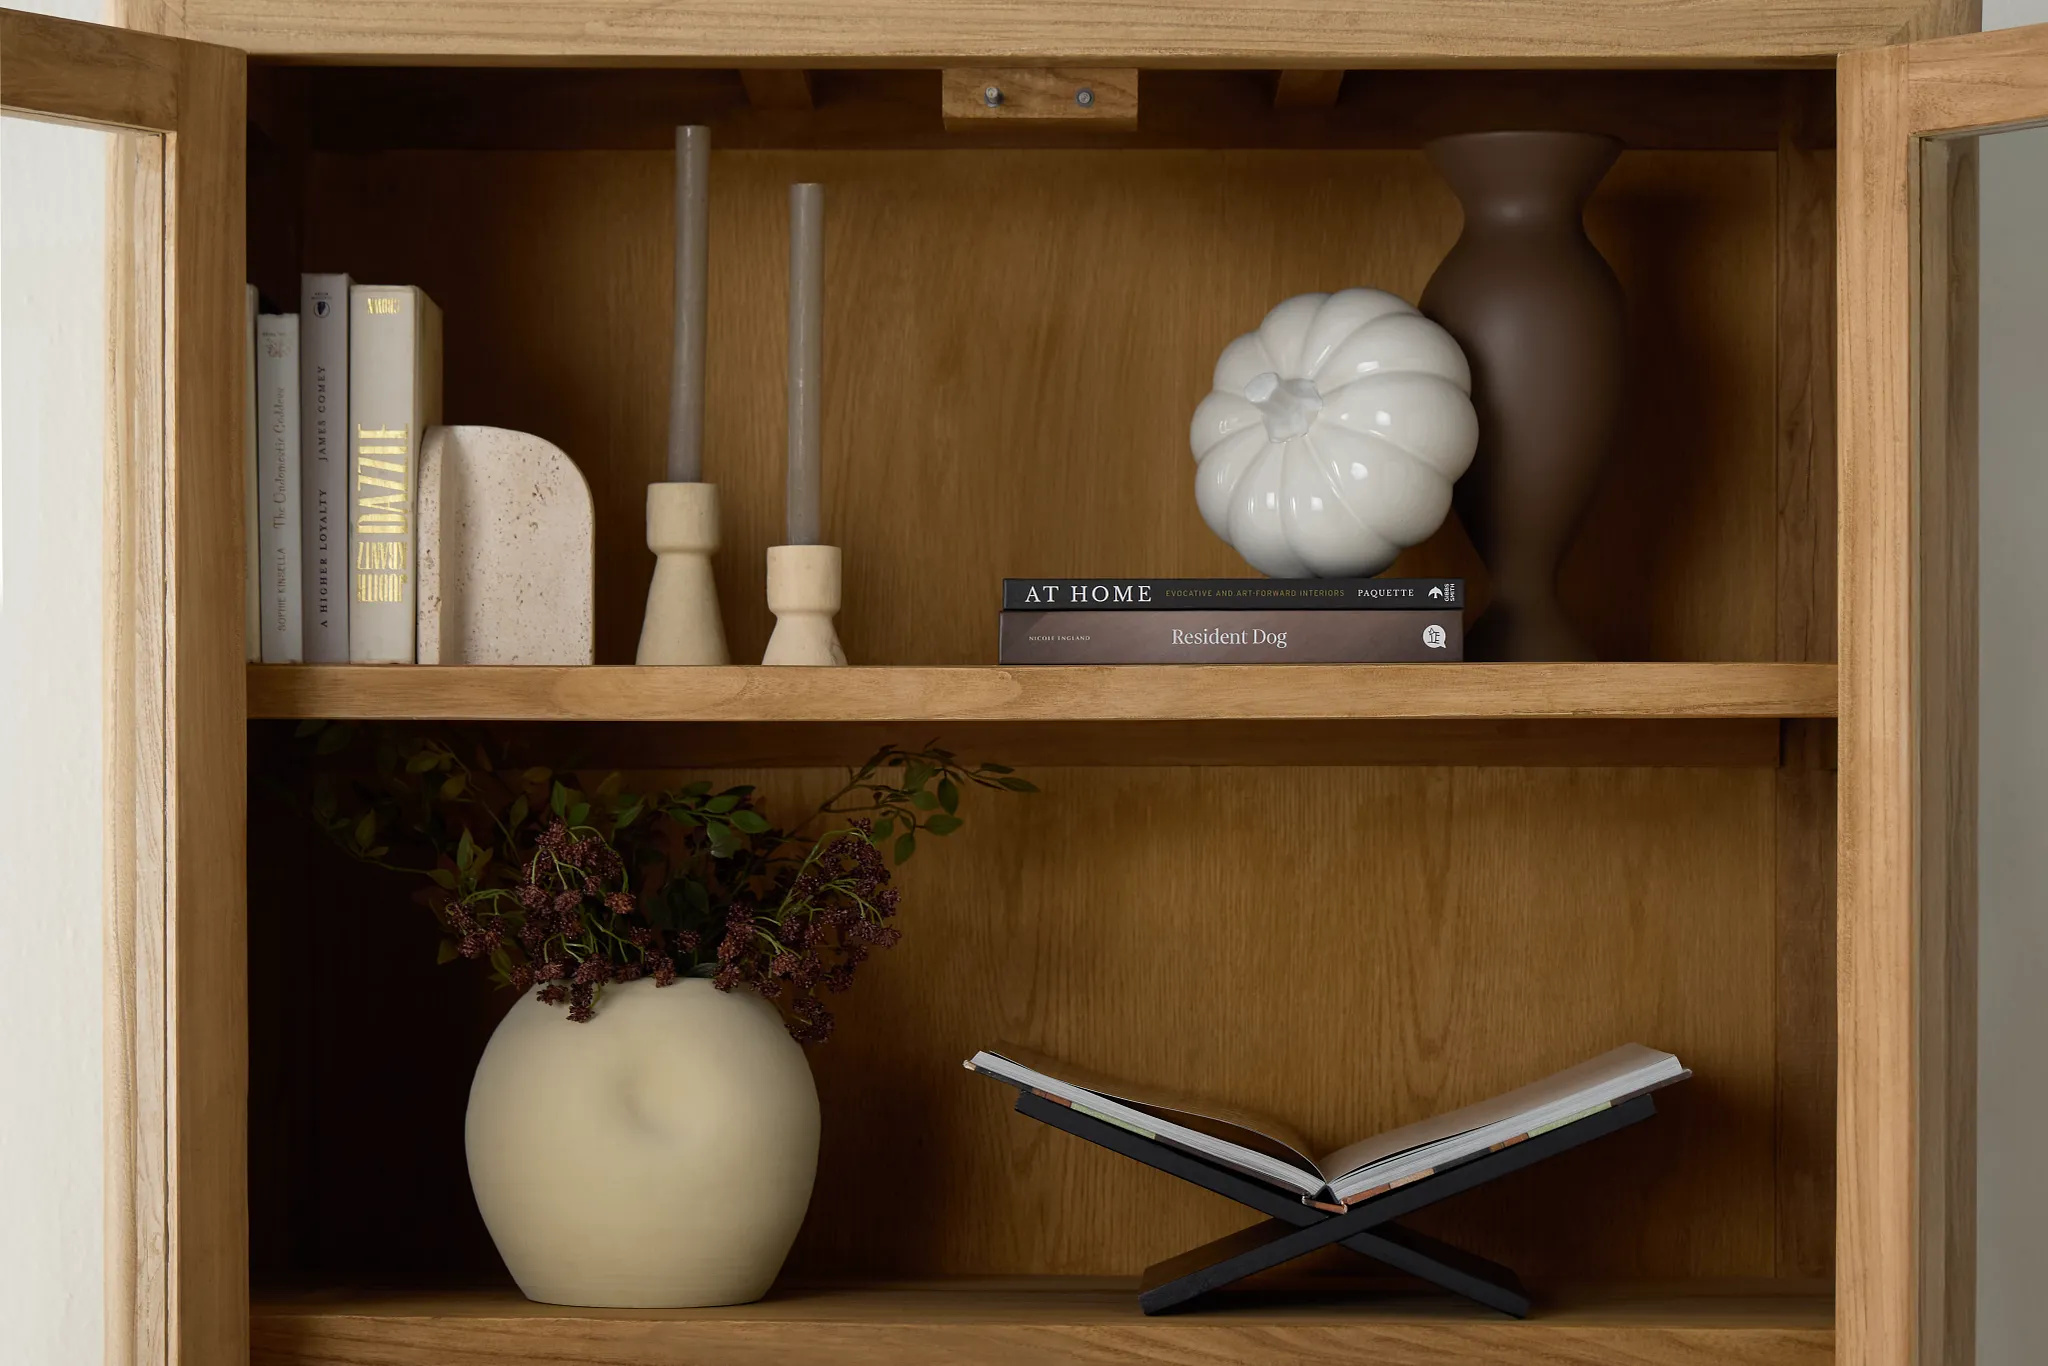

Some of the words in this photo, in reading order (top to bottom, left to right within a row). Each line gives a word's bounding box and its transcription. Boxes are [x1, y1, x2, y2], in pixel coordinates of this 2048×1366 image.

[317, 366, 326, 413] COMEY
[317, 420, 328, 462] JAMES
[273, 438, 287, 504] Undomestic
[357, 423, 409, 534] DAZZLE
[273, 508, 287, 529] The
[318, 488, 328, 551] LOYALTY
[357, 541, 409, 570] KRANTZ
[277, 549, 287, 594] KINSELLA
[319, 557, 328, 613] HIGHER
[357, 573, 409, 603] JUDITH
[1024, 585, 1059, 603] AT
[1070, 585, 1152, 603] HOME
[1165, 589, 1213, 597] EVOCATIVE
[1216, 589, 1233, 597] AND
[1236, 589, 1297, 597] ART-FORWARD
[1299, 589, 1345, 597] INTERIORS
[1357, 588, 1414, 598] PAQUETTE
[277, 599, 287, 632] SOPHIE
[319, 619, 328, 628] A
[1171, 628, 1248, 645] Resident
[1251, 628, 1288, 649] Dog
